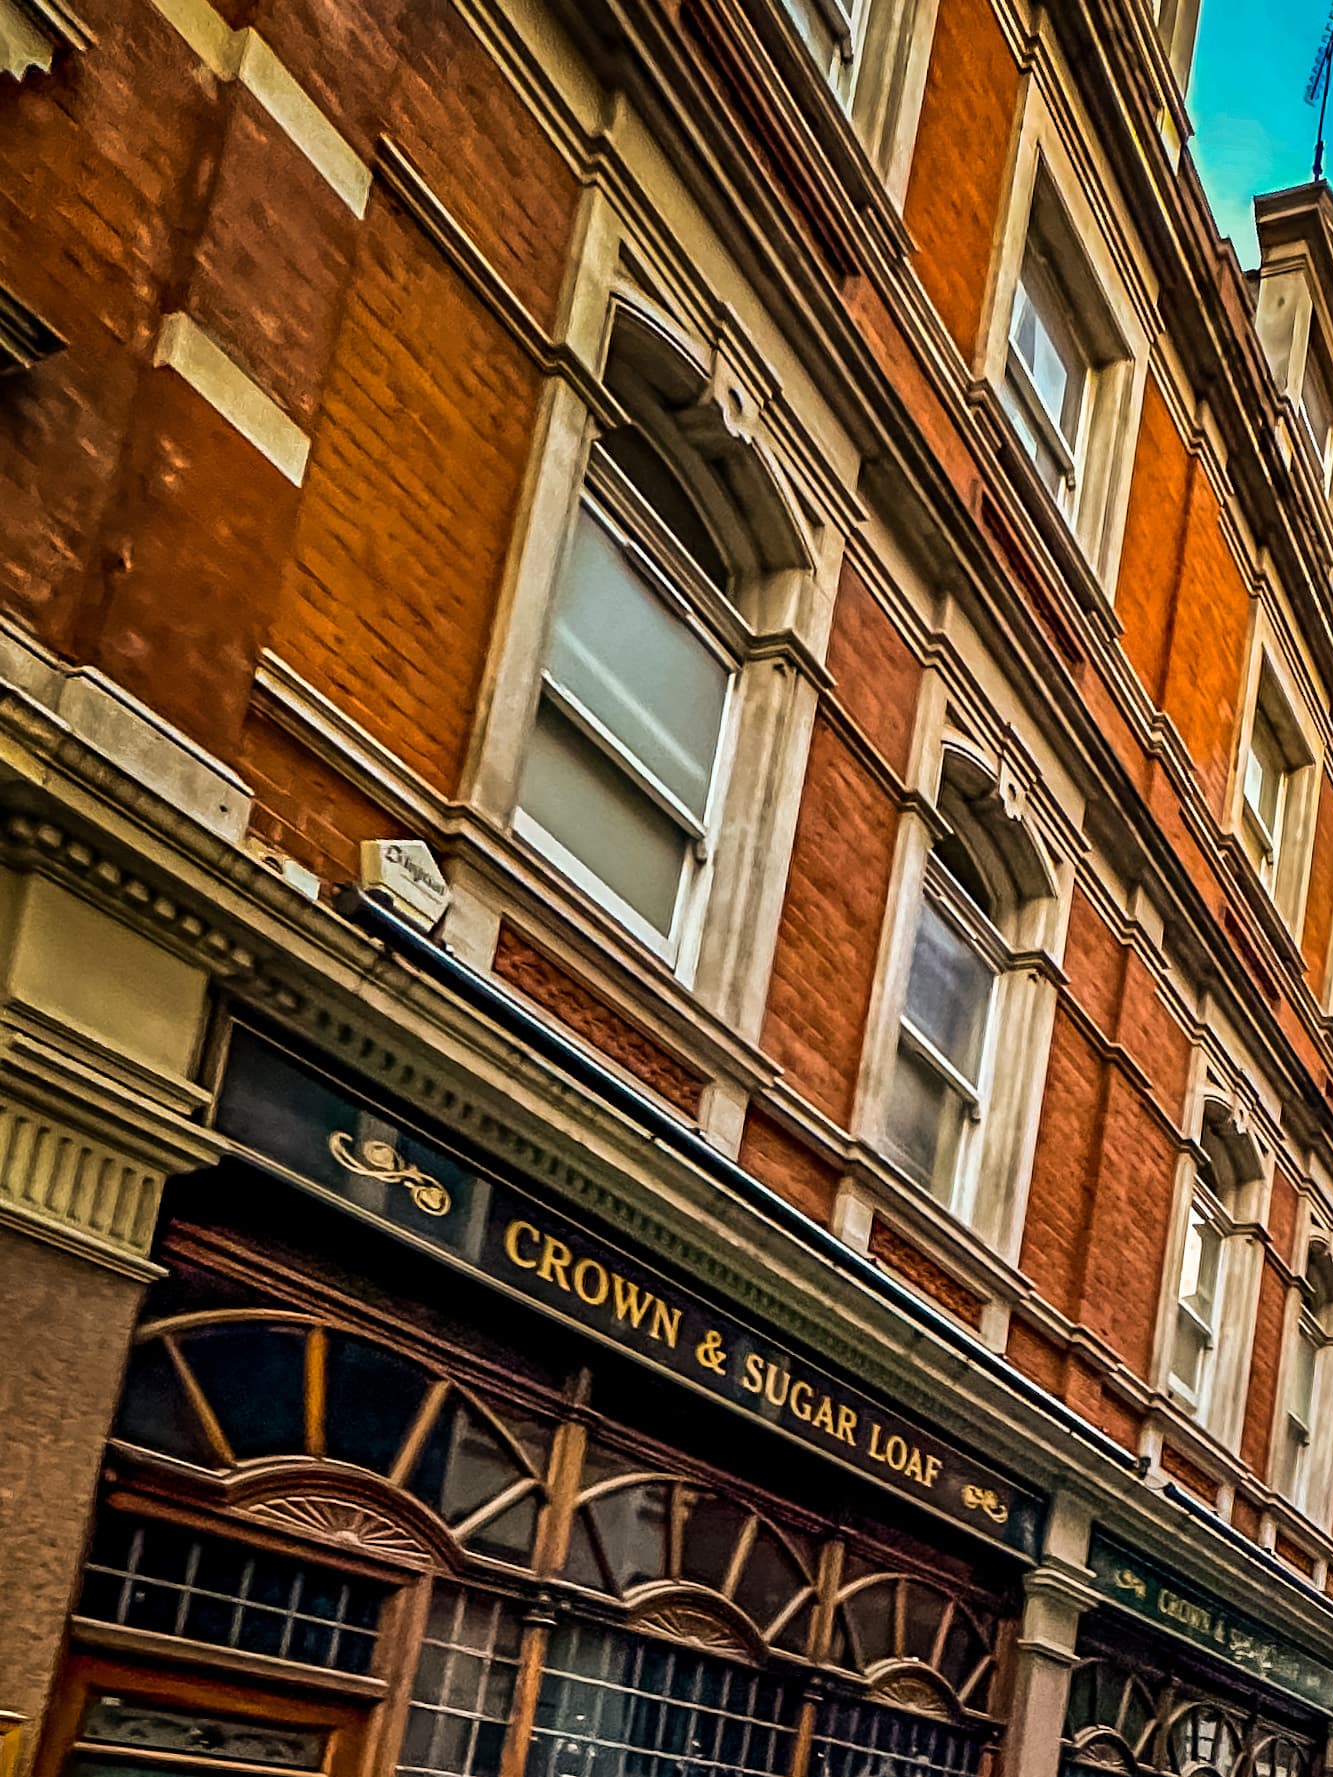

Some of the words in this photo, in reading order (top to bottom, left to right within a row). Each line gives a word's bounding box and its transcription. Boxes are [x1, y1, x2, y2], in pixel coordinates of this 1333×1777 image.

[505, 1219, 683, 1349] CROWN
[696, 1329, 728, 1377] &
[743, 1350, 859, 1448] SUGAR
[867, 1421, 944, 1489] LOAF
